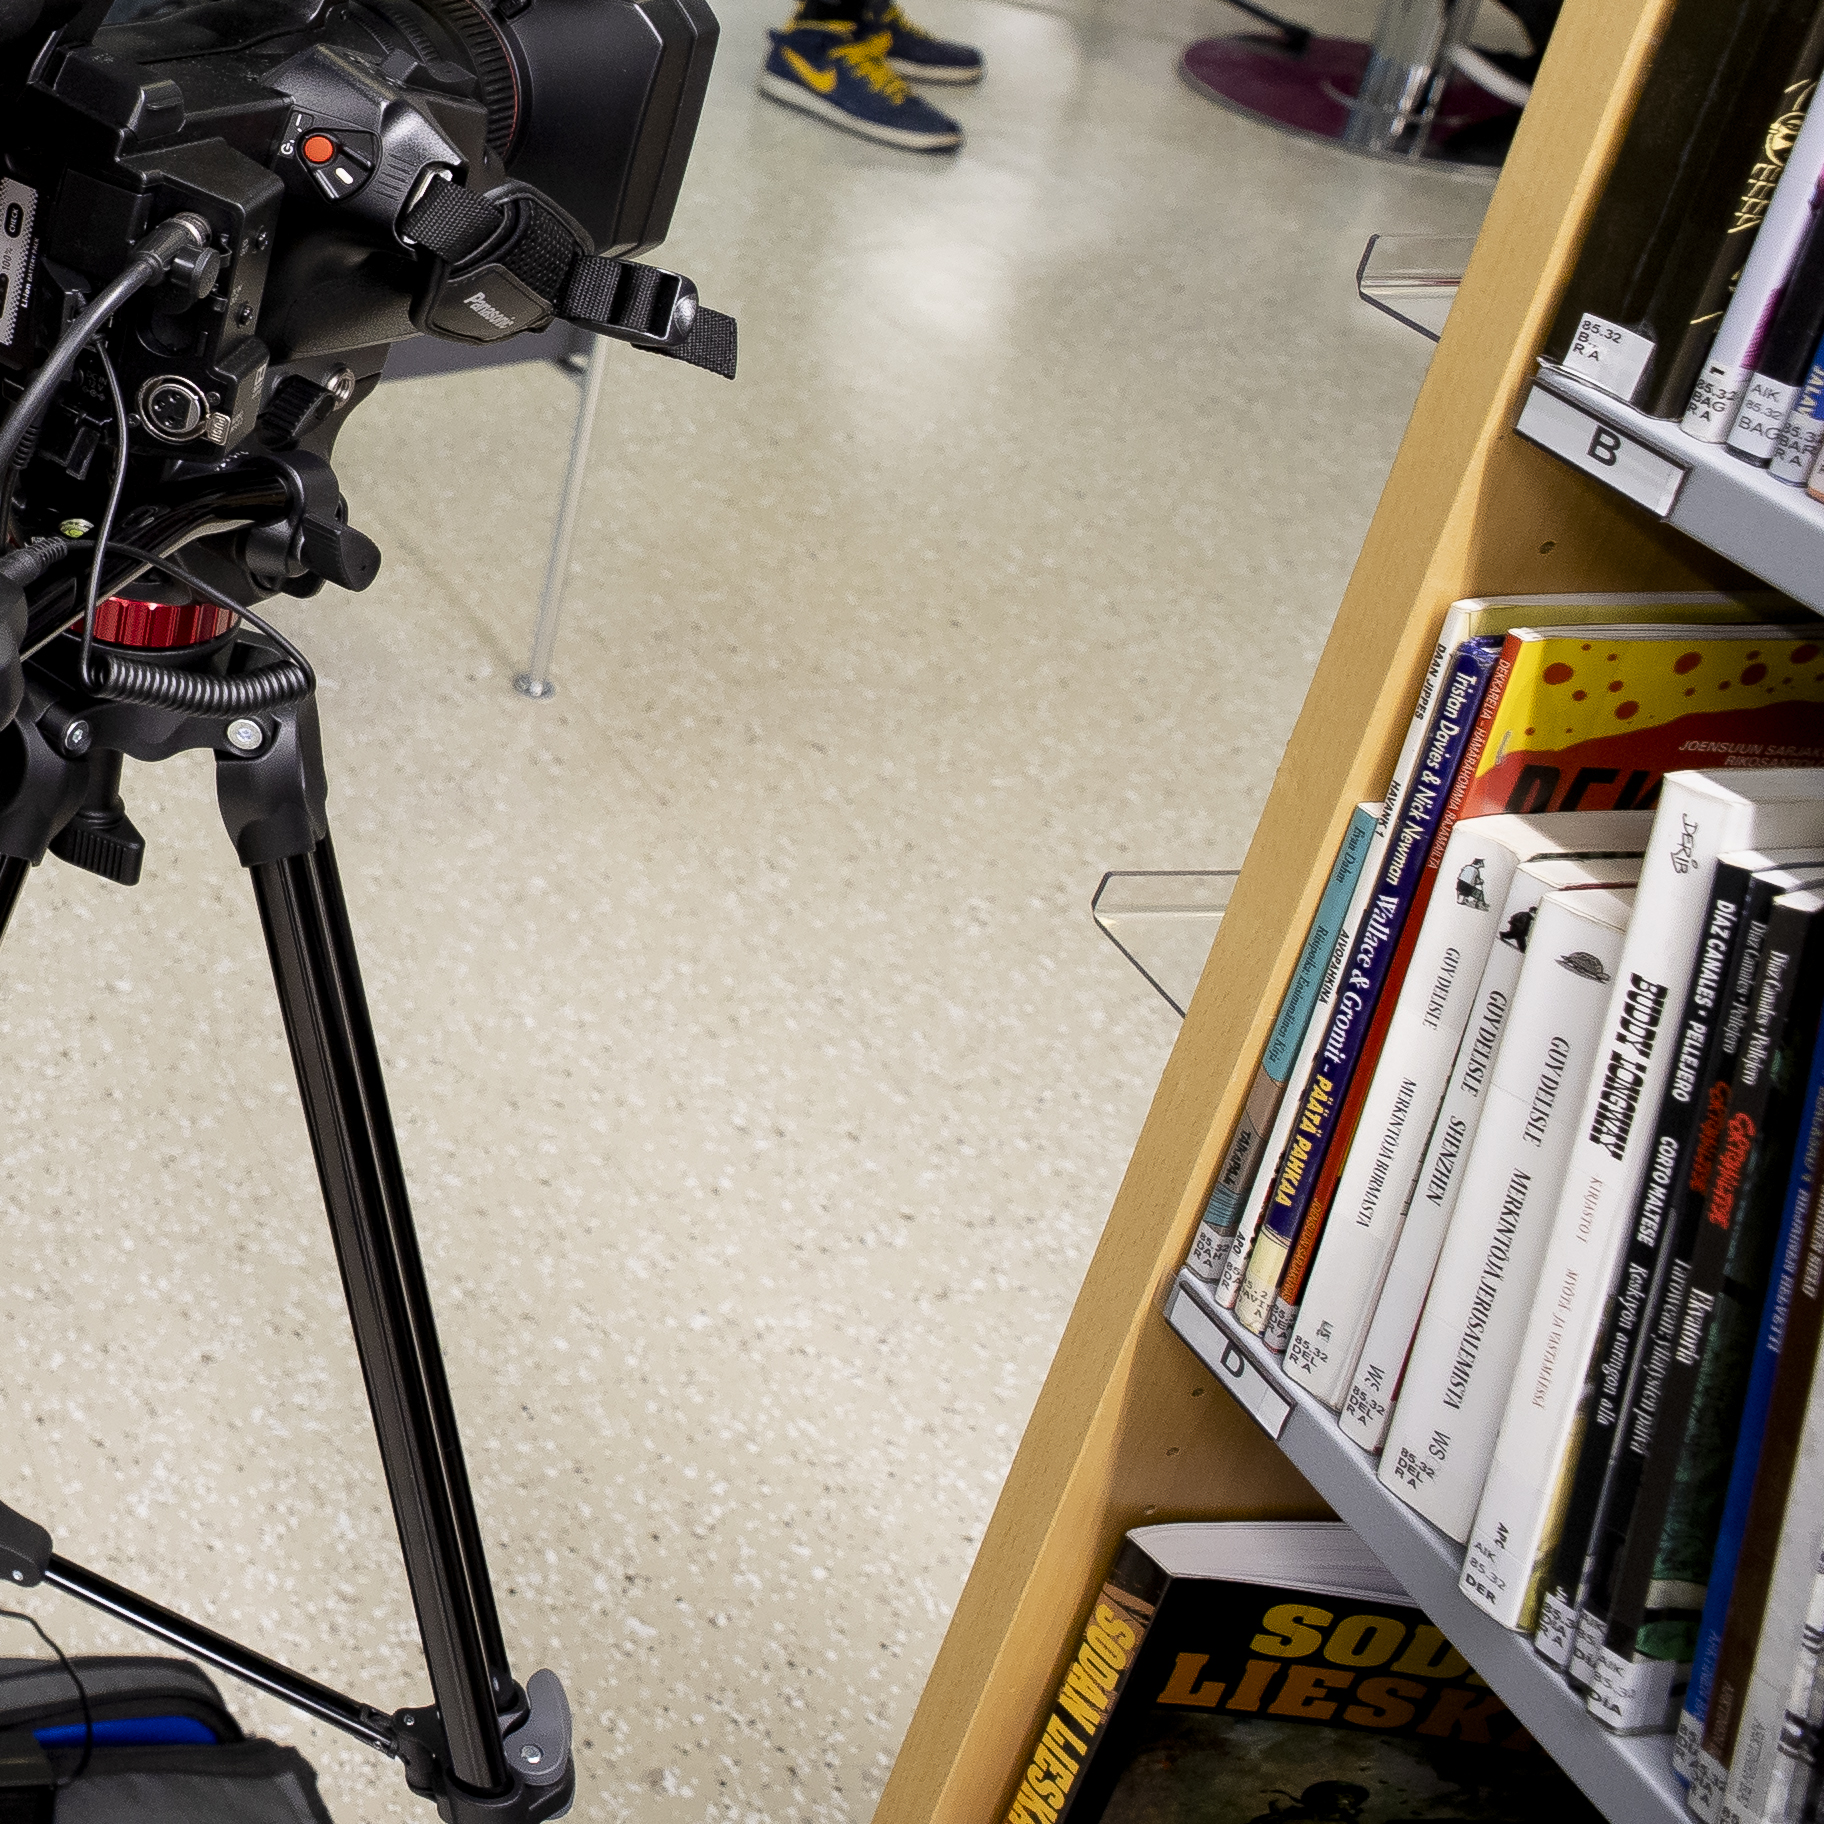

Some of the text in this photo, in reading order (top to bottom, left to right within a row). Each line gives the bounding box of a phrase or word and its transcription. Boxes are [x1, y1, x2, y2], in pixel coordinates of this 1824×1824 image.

[9, 208, 19, 233] CHECK
[463, 291, 516, 329] Panasonic
[1581, 319, 1623, 345] 85.32
[1752, 381, 1780, 403] AIK
[1586, 425, 1623, 467] B
[1424, 642, 1447, 678] DAAN
[1414, 678, 1436, 721] JIPPES
[1442, 670, 1478, 720] Tristan
[1479, 657, 1512, 721] DEKKARELIA
[1425, 718, 1461, 771] Davies
[1679, 740, 1763, 755] JOENSUUN
[1422, 769, 1441, 787] &
[1379, 779, 1402, 829] HAVANK
[1408, 783, 1437, 823] Nick
[1347, 825, 1367, 853] Evan
[1385, 821, 1426, 886] Newman
[1334, 850, 1357, 885] Dahm
[1355, 893, 1402, 966] Wallace
[1350, 968, 1371, 989] &
[1443, 946, 1461, 978] GUY
[1695, 938, 1725, 1007] CANALES
[1422, 976, 1454, 1031] DELISLE
[1614, 972, 1669, 1060] BUDDY
[1323, 988, 1364, 1063] Gromit
[1543, 1035, 1571, 1078] GUY
[1671, 1021, 1708, 1104] PELLEJERO
[1297, 1072, 1335, 1138] PÄÄTÄ
[1425, 989, 1508, 1207] GUY DELISLE SHENZHEN
[1522, 1076, 1562, 1148] DELISLE
[1588, 1049, 1648, 1162] LONGWAY
[1650, 1135, 1680, 1186] CORTO
[1355, 1160, 1390, 1228] BURMASTA
[1581, 1175, 1604, 1231] KIRJASTO
[1636, 1181, 1667, 1248] MALTESE
[1219, 1338, 1246, 1379] D
[1292, 1346, 1319, 1370] DEL
[1293, 1335, 1329, 1363] 85.32
[1442, 1275, 1498, 1411] JERUSALEMISTA
[1601, 1331, 1630, 1397] auringon
[1353, 1385, 1386, 1416] 85.32
[1596, 1396, 1618, 1426] alla
[1399, 1444, 1436, 1479] 85.32
[1473, 1540, 1497, 1564] AIK
[1465, 1573, 1498, 1605] DER
[1468, 1556, 1508, 1592] 85.32
[1055, 1602, 1138, 1735] SODAN
